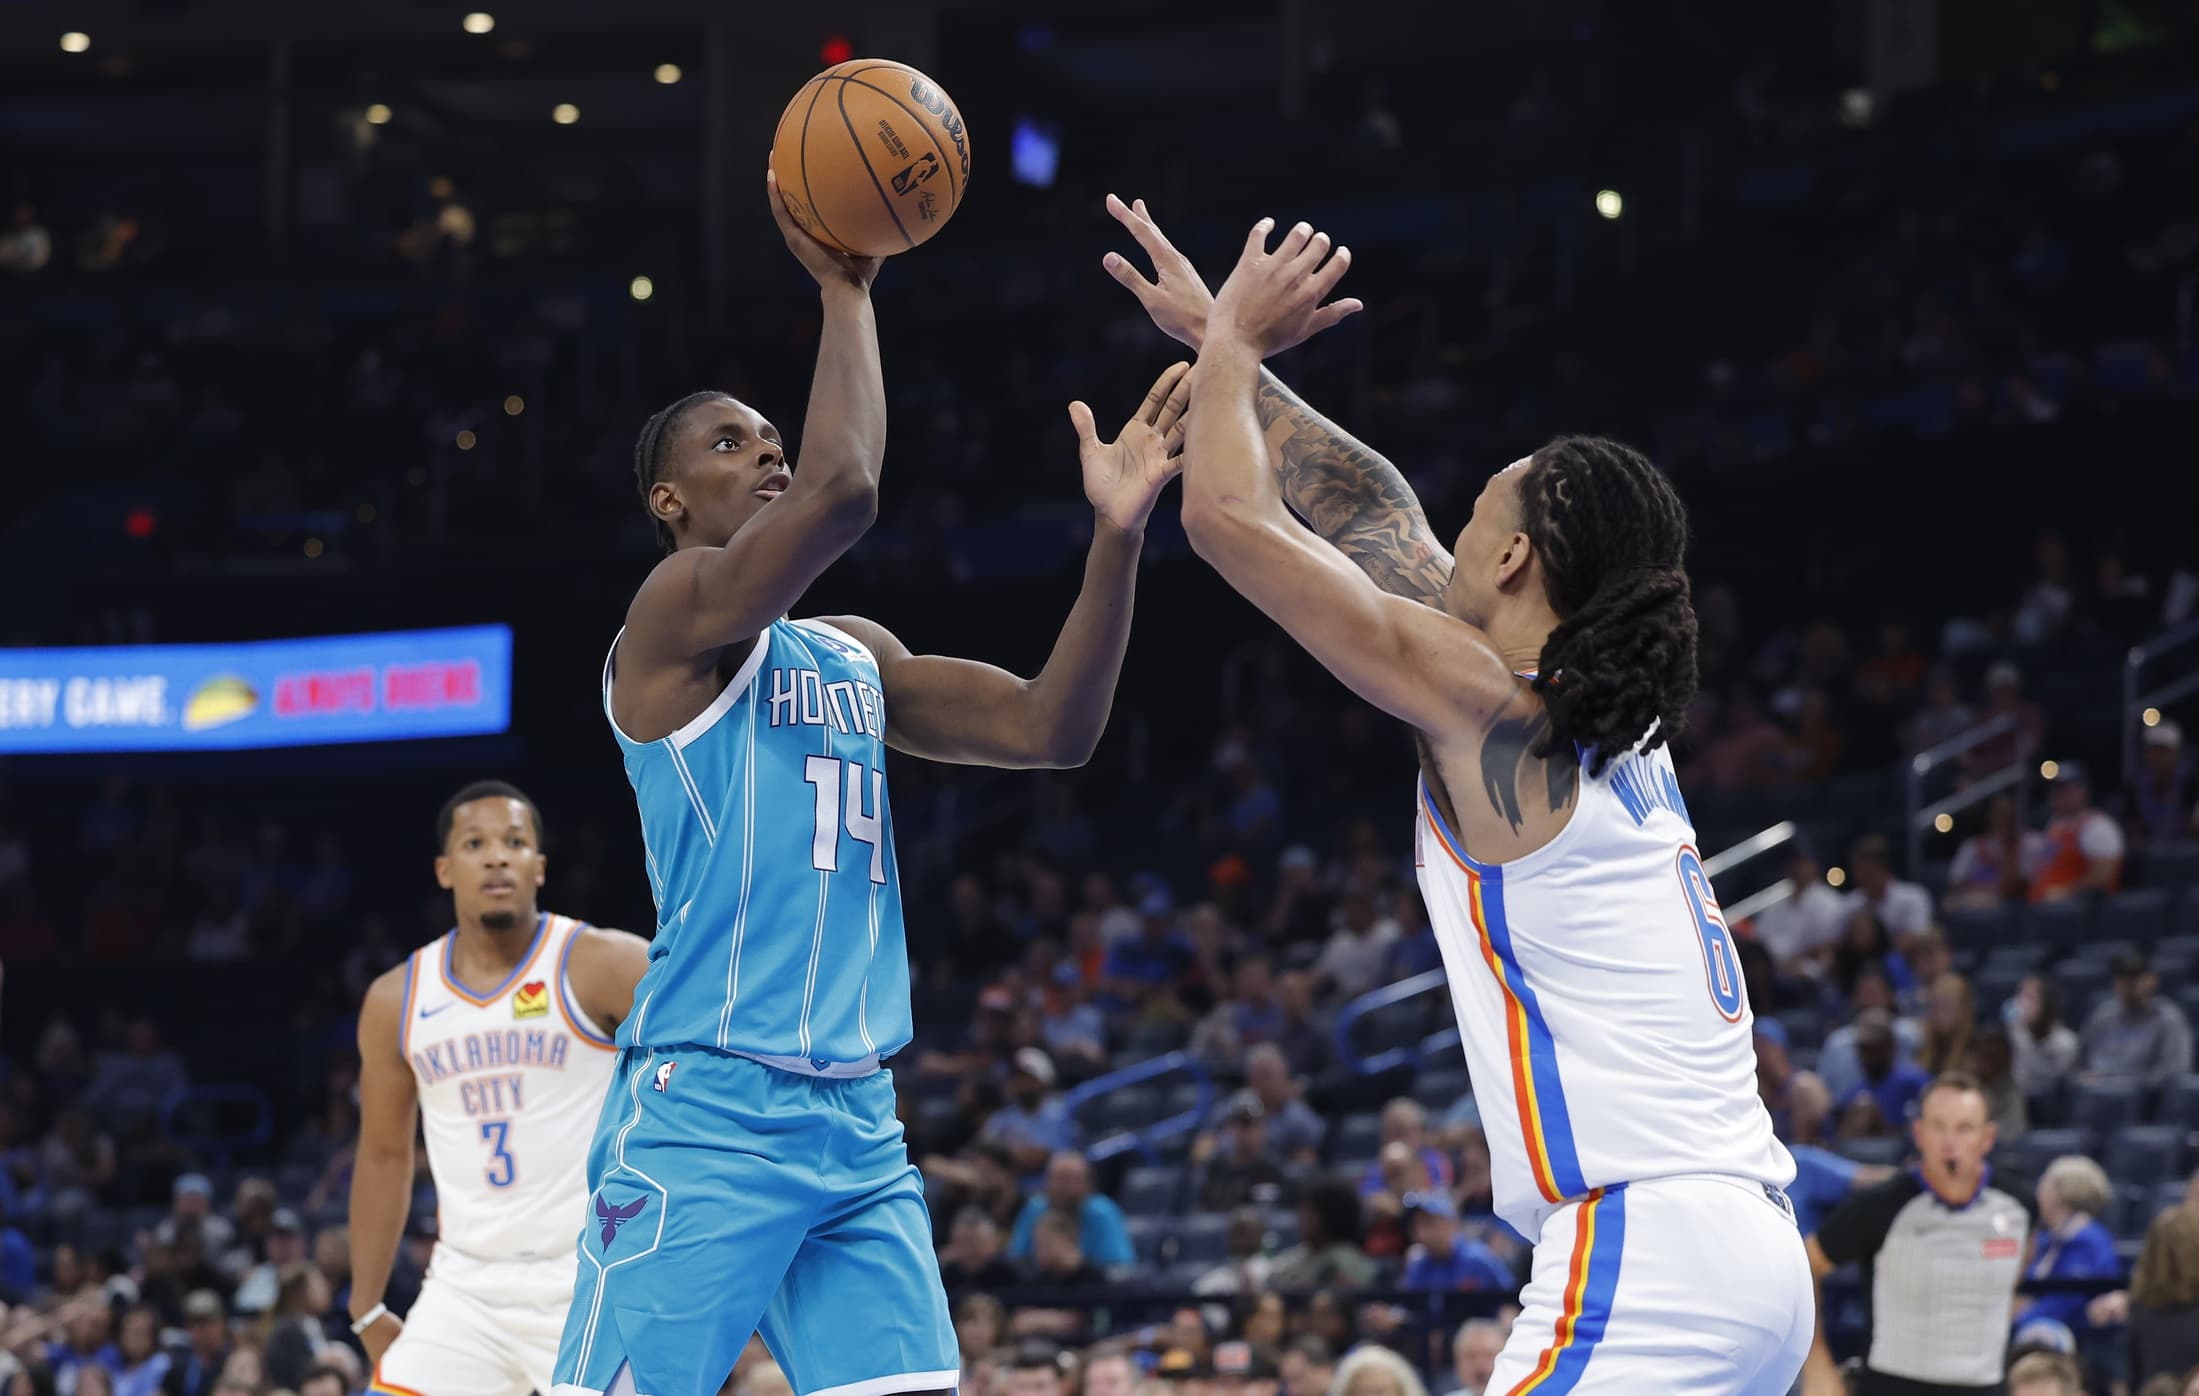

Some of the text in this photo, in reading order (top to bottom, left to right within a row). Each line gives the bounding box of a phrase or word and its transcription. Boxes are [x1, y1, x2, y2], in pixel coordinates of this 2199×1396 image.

[910, 77, 969, 191] Wilso
[803, 755, 888, 884] 14
[1676, 844, 1743, 1023] 6
[413, 1028, 570, 1086] OKLAHOMA
[460, 1072, 525, 1117] CITY
[477, 1116, 521, 1194] 3
